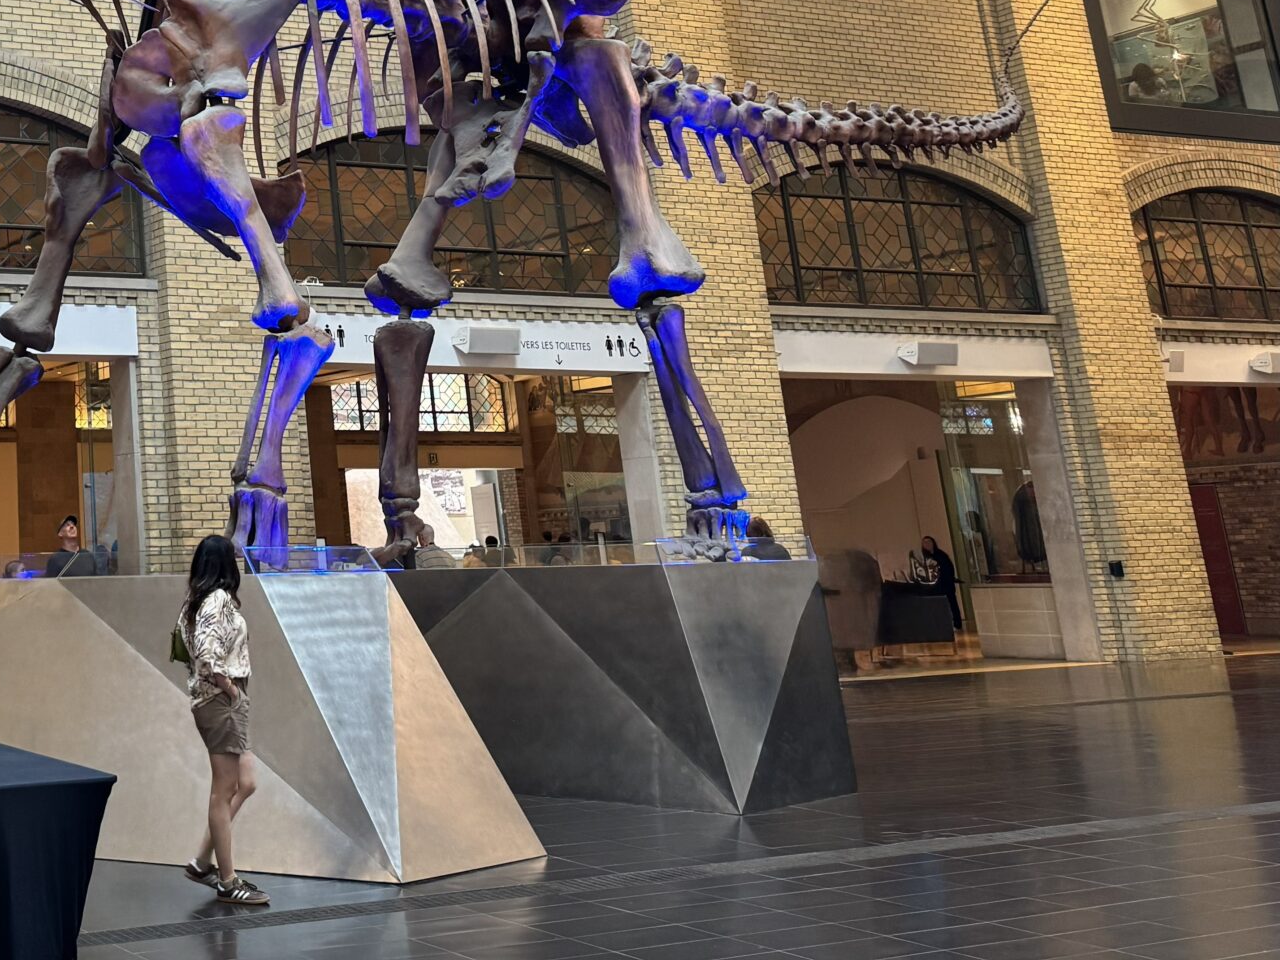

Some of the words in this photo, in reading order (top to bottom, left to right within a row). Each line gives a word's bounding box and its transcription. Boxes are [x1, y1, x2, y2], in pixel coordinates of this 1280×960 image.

[520, 340, 540, 350] VERS
[541, 341, 554, 350] LES
[555, 341, 592, 351] TOILETTES
